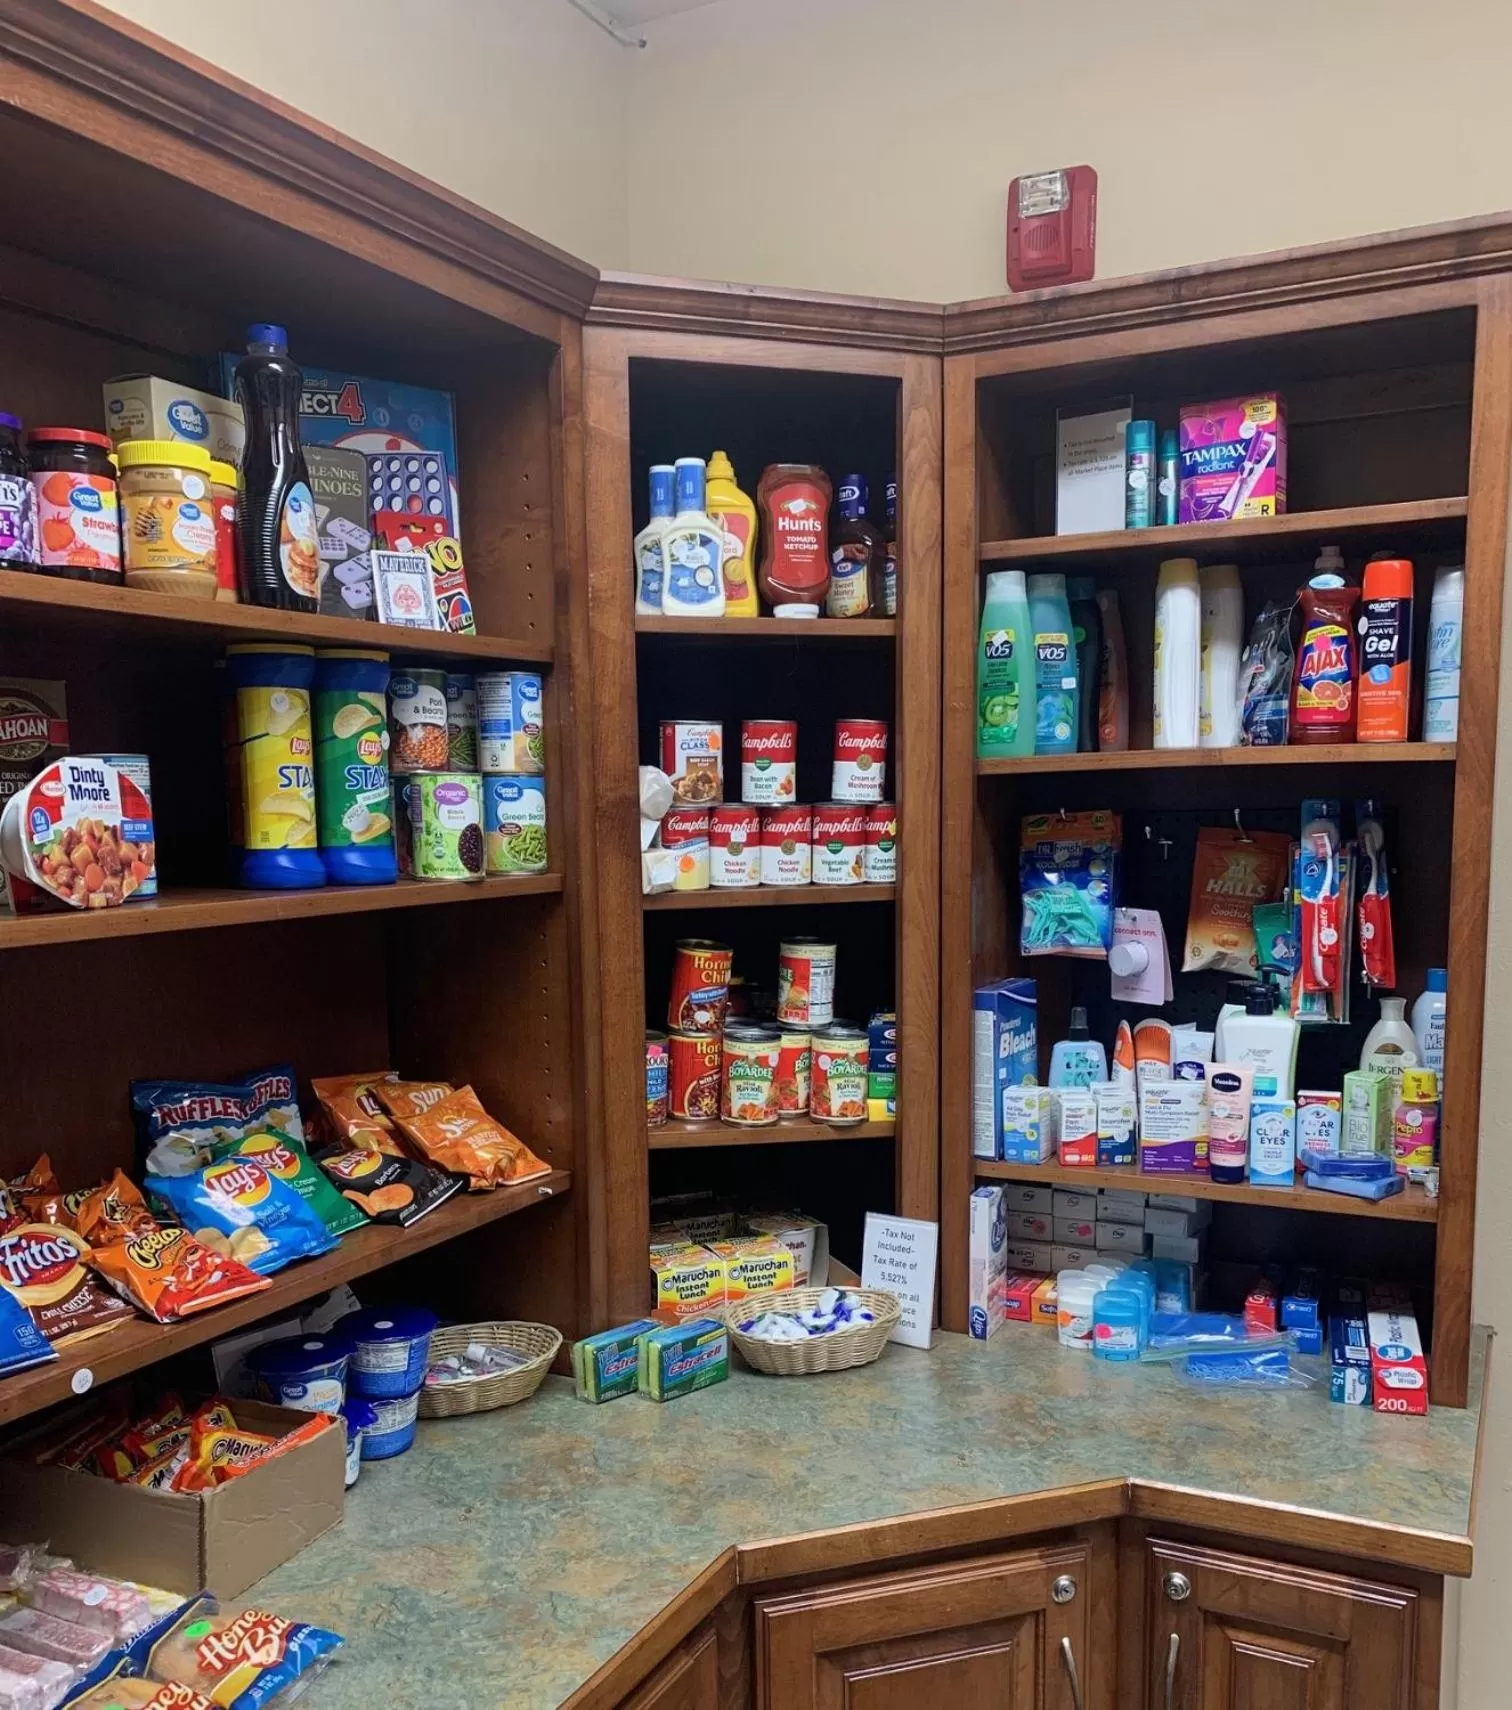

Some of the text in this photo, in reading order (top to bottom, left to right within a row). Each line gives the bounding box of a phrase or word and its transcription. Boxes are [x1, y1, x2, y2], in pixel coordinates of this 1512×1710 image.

[1183, 442, 1246, 466] TAMPAX
[1198, 461, 1235, 474] radiant
[72, 491, 99, 501] Great
[1260, 504, 1270, 516] R
[786, 535, 816, 543] TOMATO
[784, 543, 819, 551] KETCHUP
[379, 556, 426, 573] MAVERICK
[1368, 600, 1399, 609] equate
[1368, 627, 1394, 635] SHAVE
[1365, 634, 1399, 653] Gel
[986, 644, 1011, 657] VO5
[1038, 647, 1065, 660] VO5
[1301, 646, 1348, 677] AJAX
[742, 731, 793, 751] Campbell's
[69, 766, 105, 788] Dinty
[436, 788, 466, 798] Organic
[497, 786, 519, 794] Great
[502, 813, 527, 821] Green
[1206, 879, 1268, 897] HALLS
[1000, 1023, 1036, 1058] Bleach
[728, 1065, 773, 1079] BOYARDEE
[736, 1084, 763, 1094] Ravioli
[836, 1082, 861, 1091] Ravioli
[408, 1088, 445, 1115] Sun
[155, 1096, 247, 1127] RUFFLES
[1349, 1118, 1368, 1133] Bio
[1256, 1128, 1290, 1137] CLR
[1260, 1136, 1286, 1146] EYES
[205, 1162, 265, 1197] Lay's
[257, 1205, 292, 1227] Vinegar
[900, 1231, 915, 1242] Not
[127, 1227, 187, 1269] Cheetos
[0, 1236, 79, 1286] Fritos
[740, 1261, 788, 1274] Maruchan
[873, 1254, 917, 1271] Tax Rate of
[671, 1269, 721, 1284] Maruchan
[743, 1272, 777, 1282] Instant
[676, 1281, 710, 1294] Instant
[747, 1281, 774, 1290] Lunch
[680, 1290, 707, 1301] Lunch
[909, 1293, 920, 1303] all
[41, 1286, 94, 1321] CHILI CHEESE
[675, 1302, 707, 1314] Chicken
[17, 1326, 35, 1337] 150
[1332, 1371, 1344, 1385] 75
[1393, 1370, 1417, 1379] Plastic
[1397, 1378, 1417, 1386] Wrap
[1378, 1398, 1408, 1412] 200
